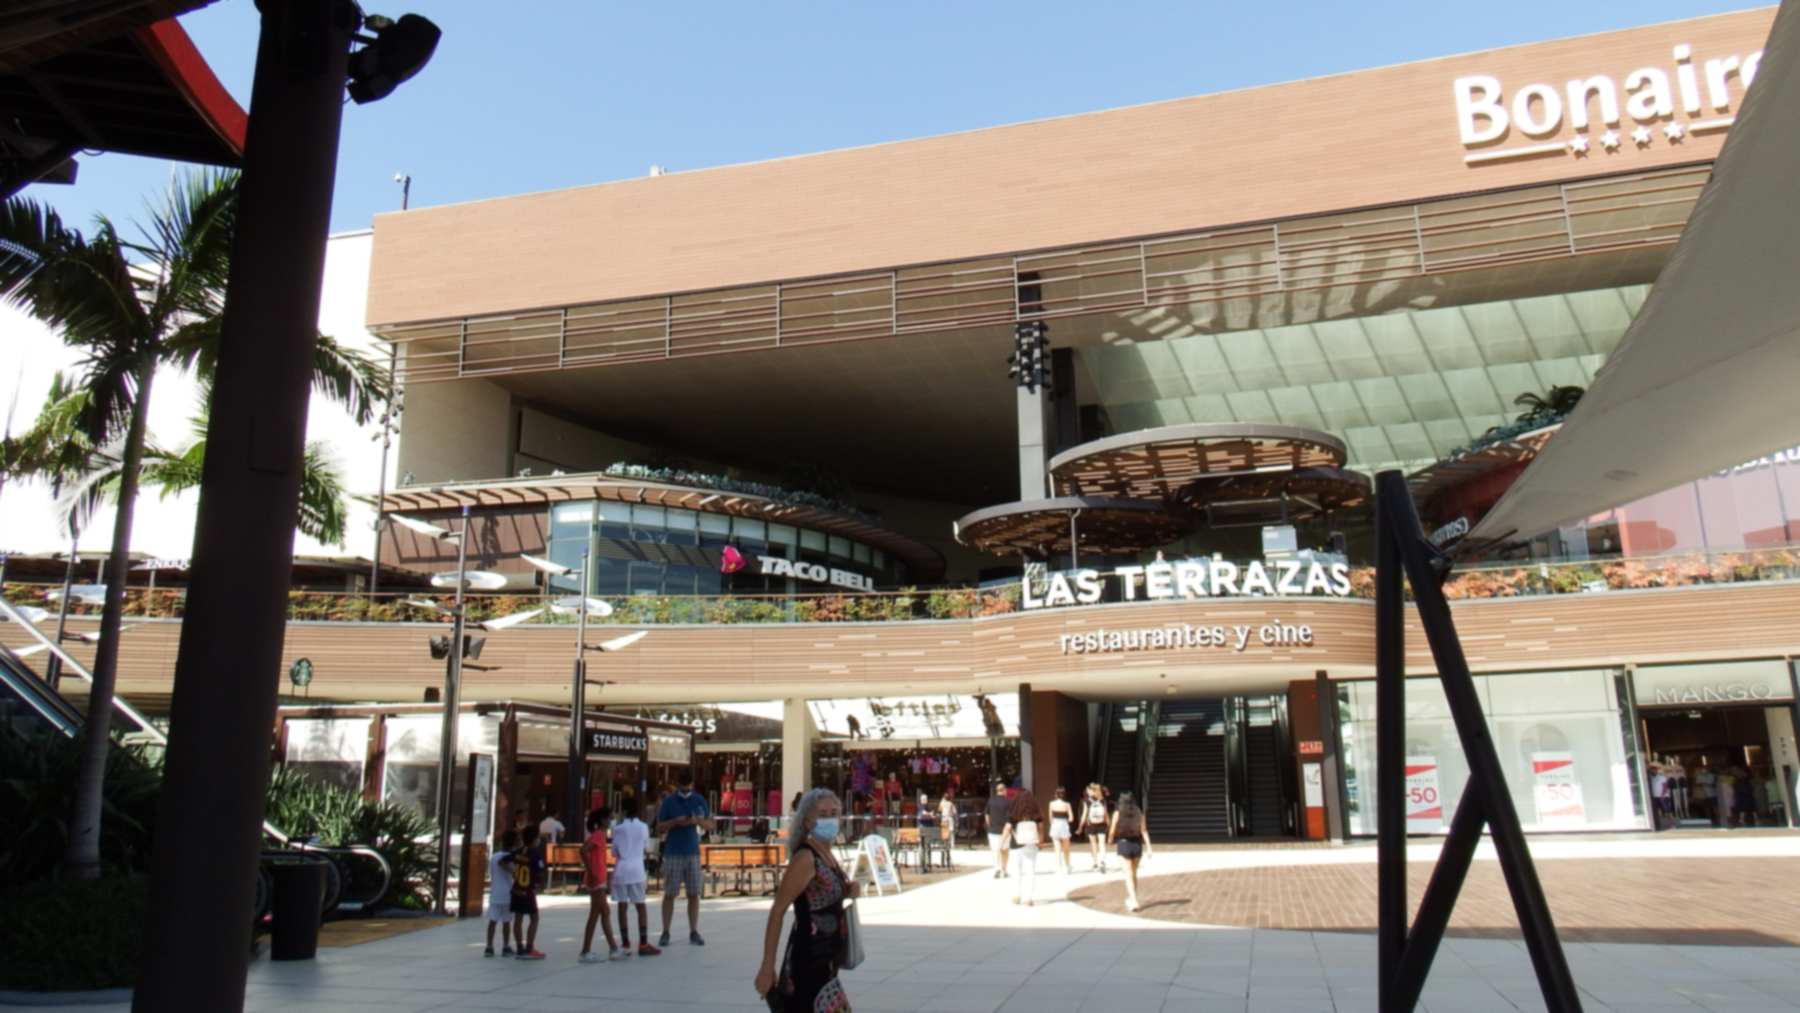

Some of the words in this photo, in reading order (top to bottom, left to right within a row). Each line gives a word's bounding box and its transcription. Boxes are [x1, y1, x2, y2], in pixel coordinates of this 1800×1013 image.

[757, 555, 828, 582] TACO
[829, 568, 876, 593] BELL
[1022, 570, 1102, 609] LAS
[1115, 560, 1352, 600] TERRAZAS
[1060, 623, 1225, 653] restaurantes
[1234, 626, 1251, 649] y
[1259, 619, 1314, 646] cine
[1655, 683, 1773, 705] MANGO
[593, 734, 647, 751] STARBUCKS
